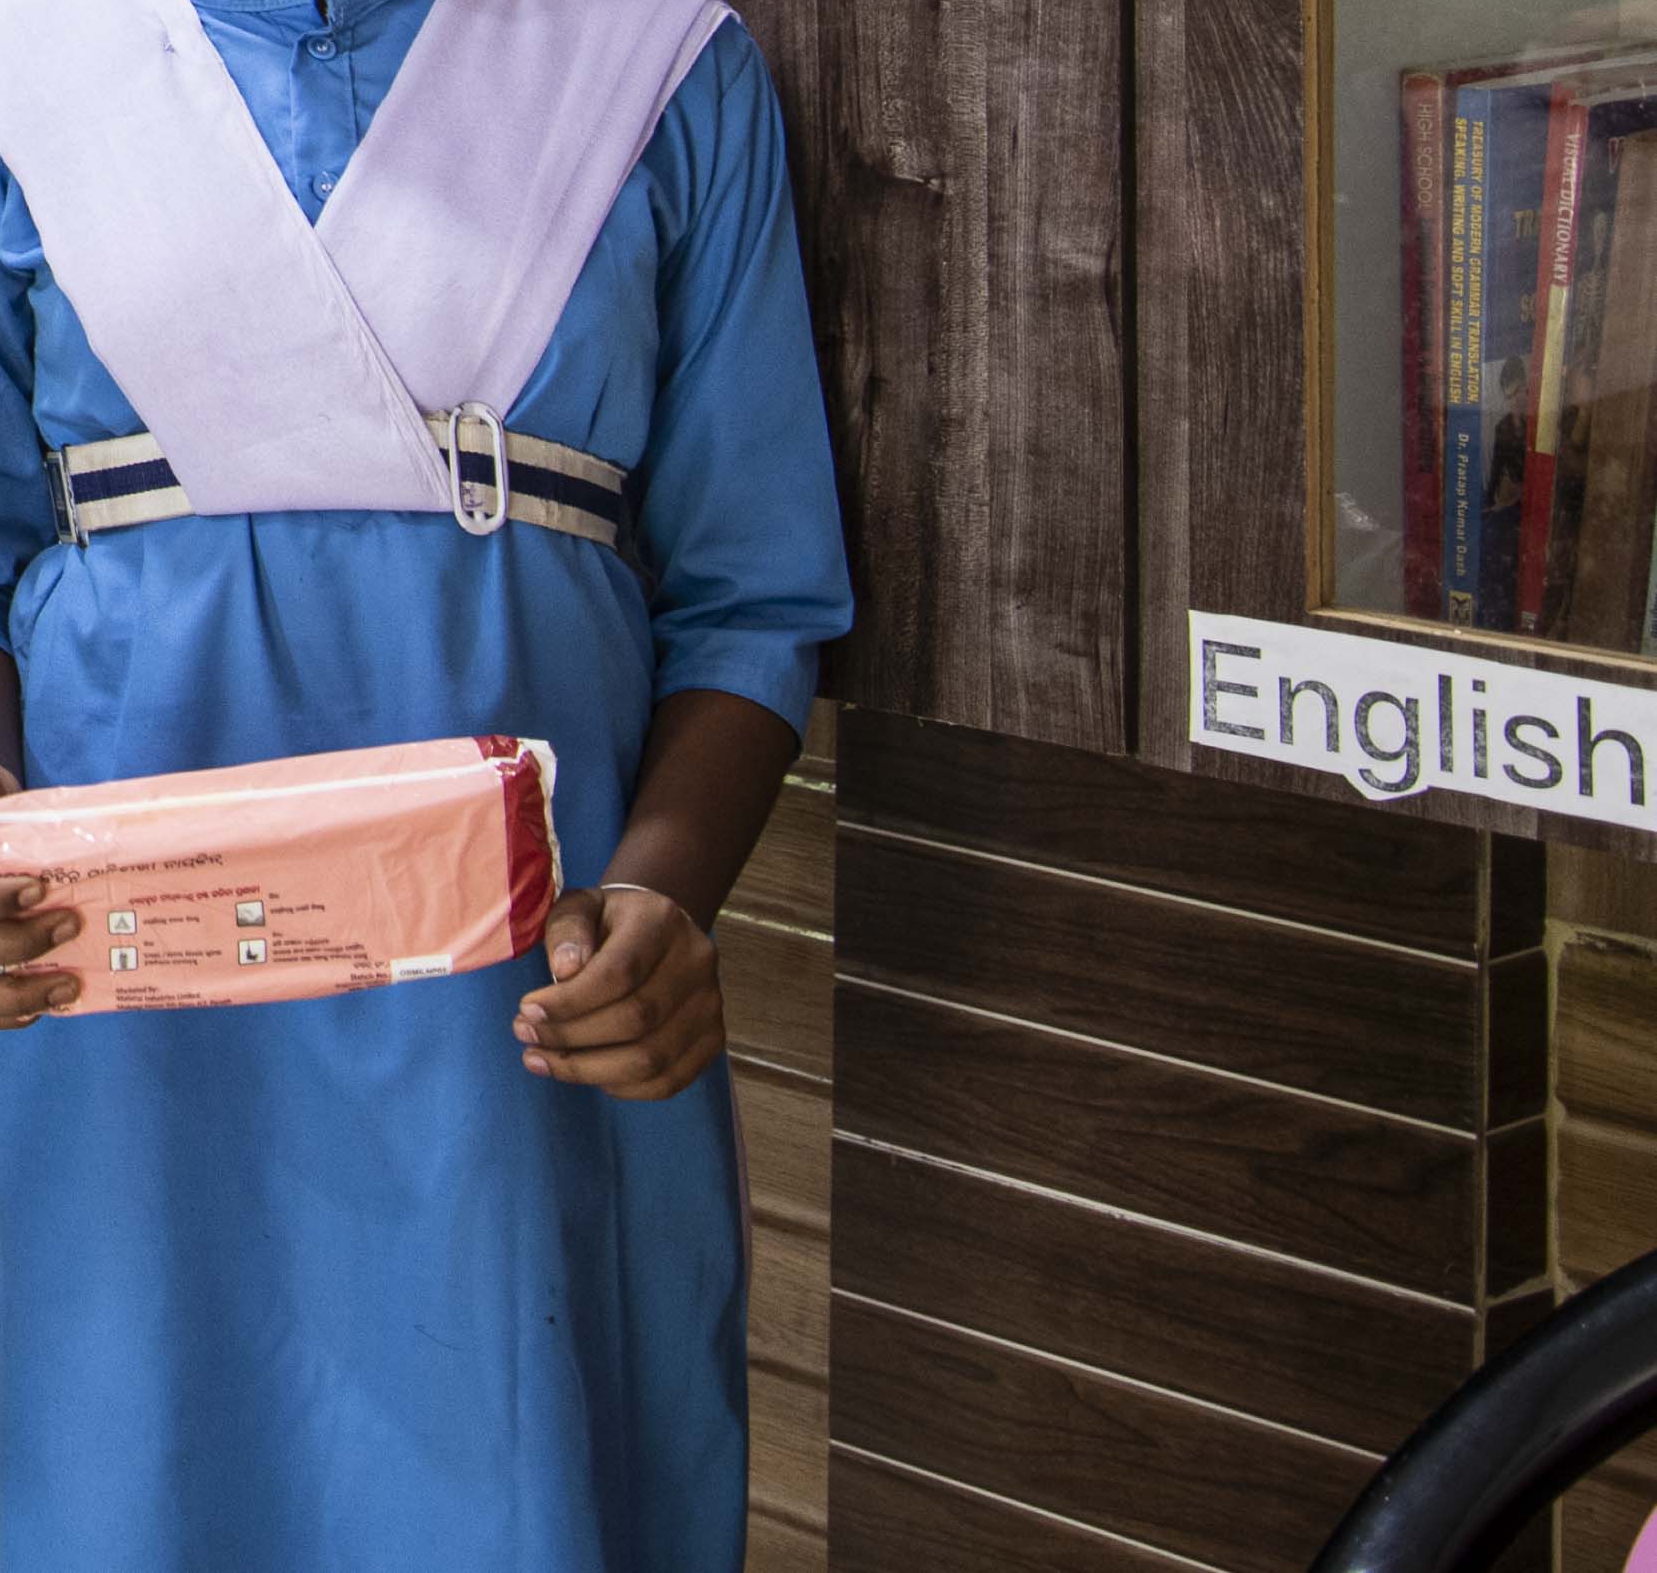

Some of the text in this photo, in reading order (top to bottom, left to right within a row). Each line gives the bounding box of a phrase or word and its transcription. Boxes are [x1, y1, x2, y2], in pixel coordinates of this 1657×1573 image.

[1417, 102, 1433, 141] HIGH
[1417, 145, 1433, 211] SCHOOL
[1452, 184, 1465, 233] WRITING
[1554, 133, 1580, 282] VISUAL DICTIONARY
[1451, 238, 1464, 261] AND
[1465, 121, 1483, 404] TREASURY OF MODERN GRAMMAR TRANSLATION,
[1451, 266, 1464, 295] SOFT
[1450, 300, 1463, 333] SKILL
[1450, 337, 1463, 349] IN
[1449, 353, 1462, 403] ENGLISH
[1455, 433, 1470, 575] Dr. Pratap Kumar Dash
[1202, 639, 1646, 806] English
